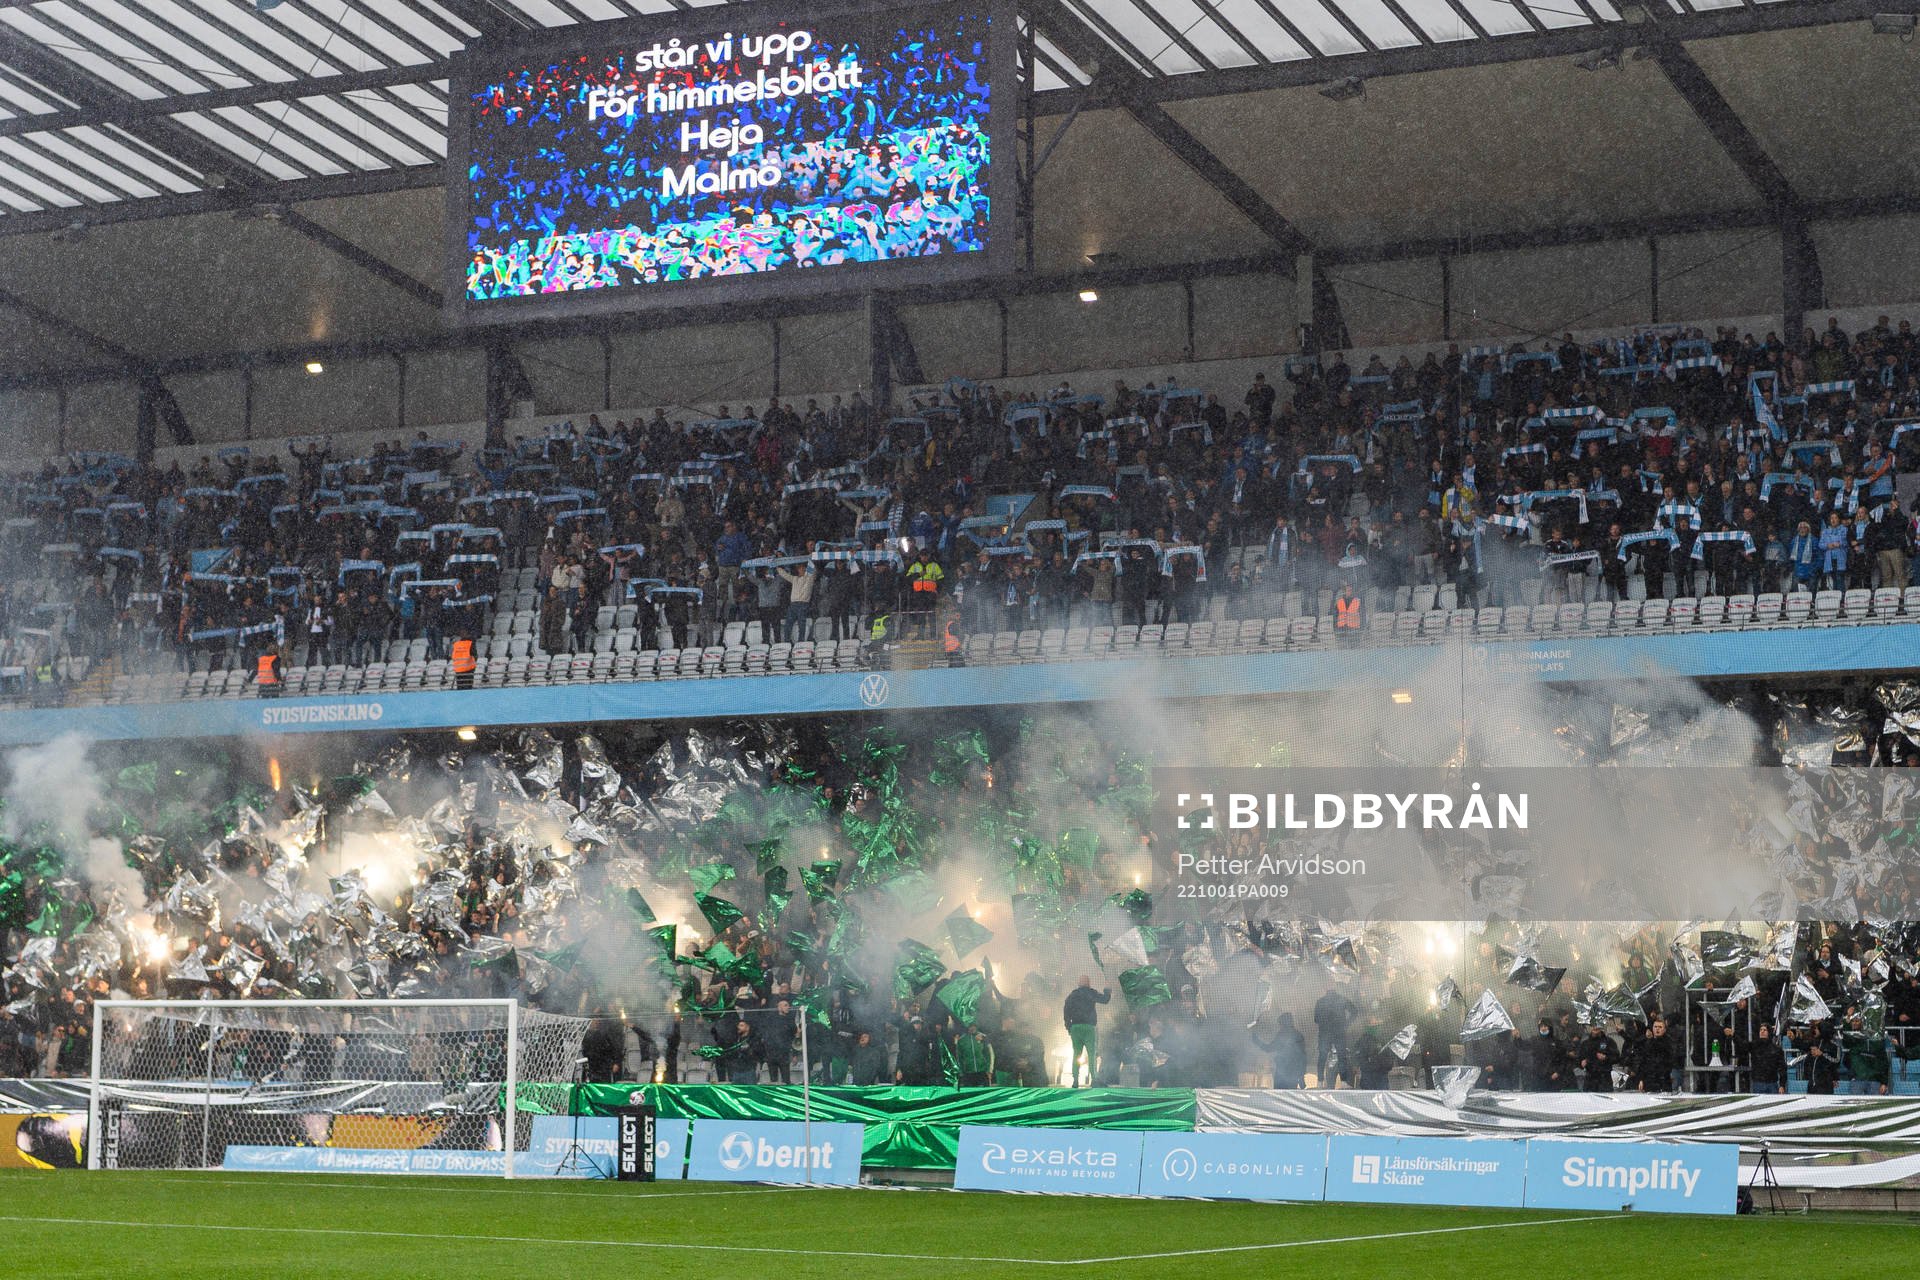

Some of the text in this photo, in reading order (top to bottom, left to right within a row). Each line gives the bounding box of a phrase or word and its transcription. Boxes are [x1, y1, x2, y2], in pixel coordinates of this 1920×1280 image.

[635, 30, 812, 73] står vi upp
[588, 60, 863, 120] För himmelsblått
[680, 119, 764, 156] Heja
[662, 159, 782, 197] Malmö
[622, 1115, 637, 1173] SELECT
[644, 1116, 654, 1173] SELECT
[756, 1137, 834, 1169] bemt
[1011, 1146, 1118, 1166] exakta
[1010, 1167, 1041, 1175] PRINT
[1072, 1170, 1116, 1178] BEYOND
[1203, 1162, 1304, 1176] CABONLINE
[1382, 1171, 1425, 1186] Skåne
[1384, 1155, 1500, 1175] Länsförsäkringar
[1562, 1156, 1701, 1197] Simplify
